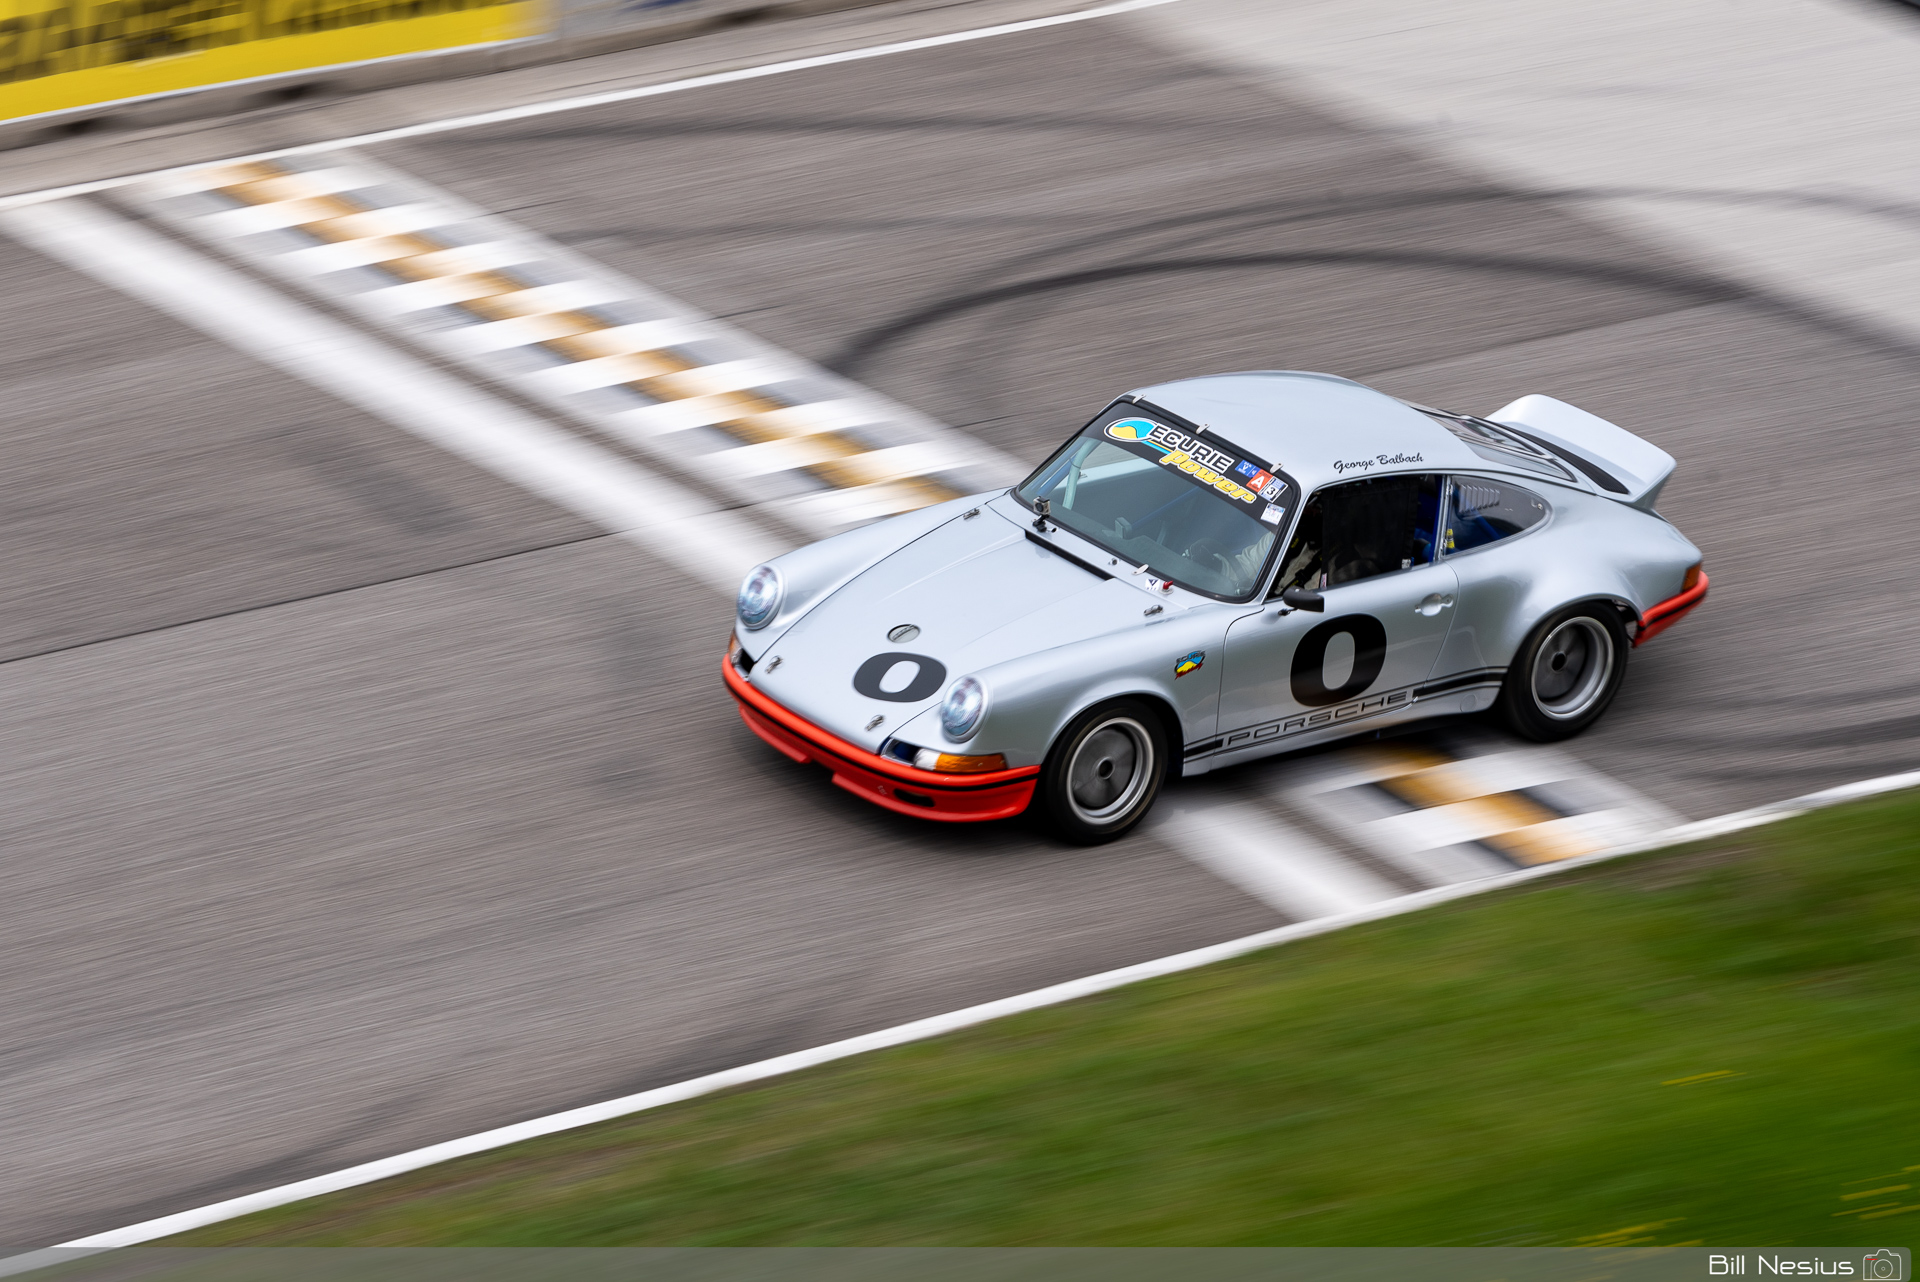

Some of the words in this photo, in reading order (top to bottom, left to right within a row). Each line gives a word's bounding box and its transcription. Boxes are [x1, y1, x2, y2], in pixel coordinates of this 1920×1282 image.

[1149, 423, 1235, 473] ECURIE
[1333, 460, 1375, 474] George
[1376, 452, 1424, 465] Balbach
[1160, 450, 1256, 503] power
[1251, 475, 1265, 489] A
[1266, 486, 1276, 495] 3
[852, 652, 947, 703] 0
[1290, 613, 1388, 707] 0
[1227, 691, 1407, 746] PORSCHE
